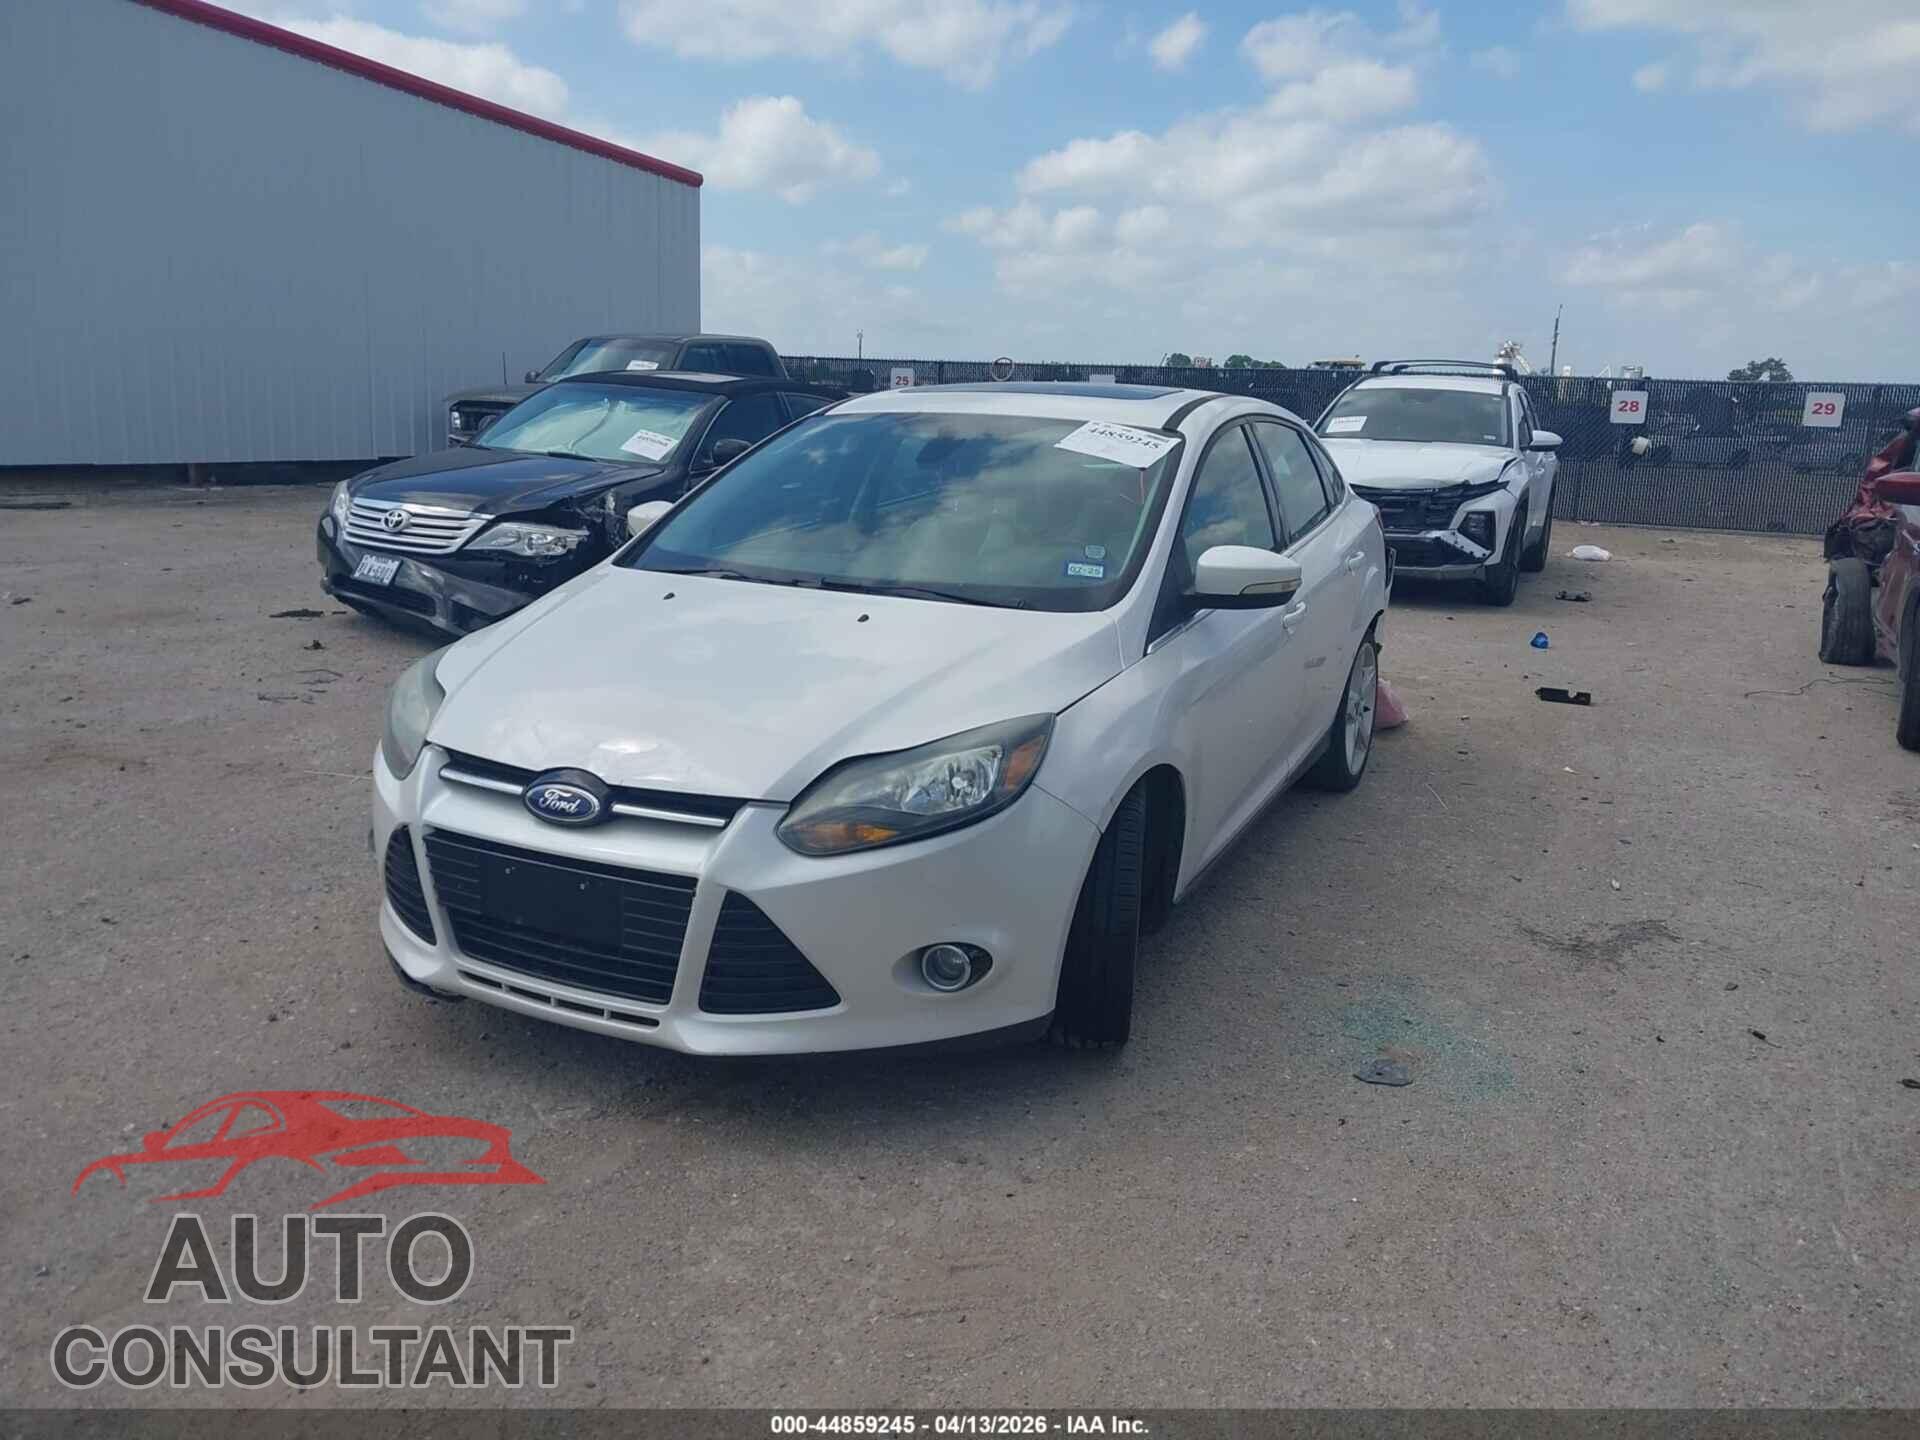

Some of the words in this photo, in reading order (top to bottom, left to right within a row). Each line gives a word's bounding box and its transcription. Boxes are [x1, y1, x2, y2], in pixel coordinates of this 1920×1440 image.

[896, 375, 909, 386] 25
[1618, 400, 1639, 413] 28
[1811, 402, 1836, 415] 29
[539, 788, 581, 813] Ford
